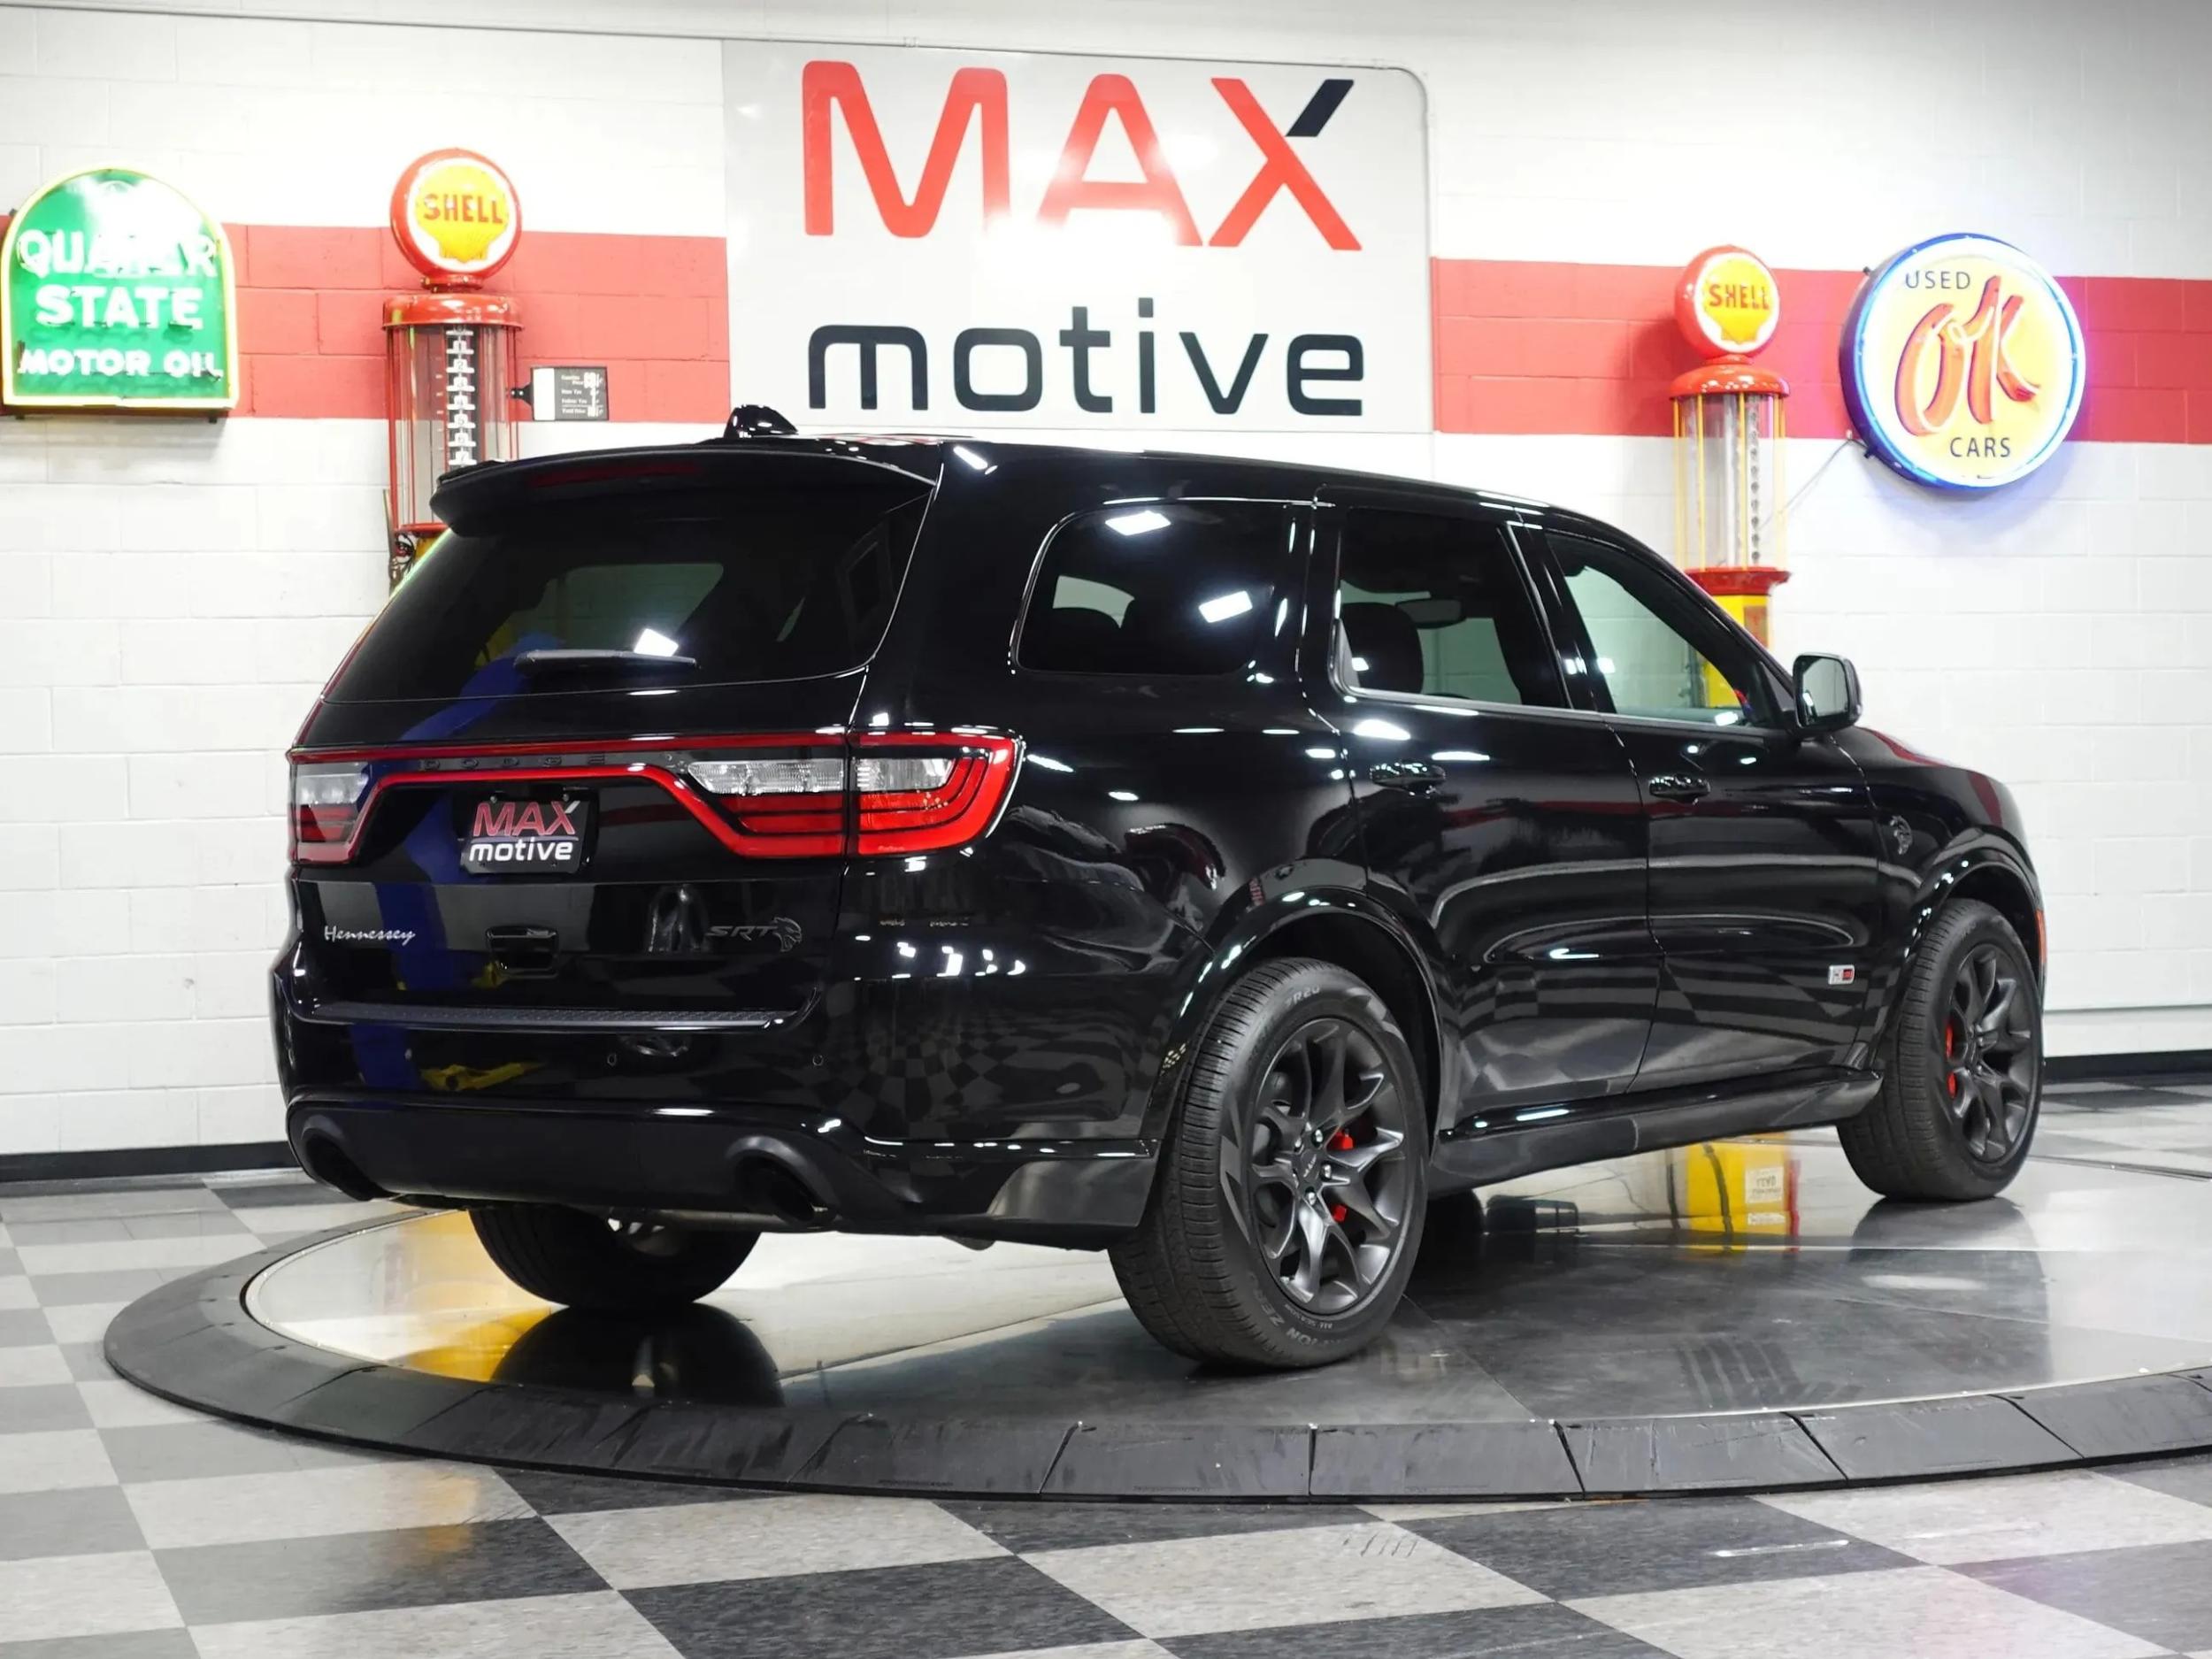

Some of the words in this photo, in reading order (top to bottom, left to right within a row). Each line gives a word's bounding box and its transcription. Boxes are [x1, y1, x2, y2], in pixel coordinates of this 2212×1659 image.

[802, 60, 1363, 251] MAX
[424, 193, 503, 224] SHELL
[1905, 271, 1971, 290] USED
[35, 284, 204, 330] STATE
[1709, 283, 1770, 311] SHELL
[18, 349, 151, 376] MOTOR
[164, 349, 224, 378] OIL
[808, 296, 1363, 416] motive
[1894, 275, 2041, 437] OK
[1949, 437, 2011, 457] CARS
[472, 800, 580, 836] MAX
[469, 837, 573, 862] motive
[324, 926, 416, 946] Hennessey
[705, 925, 778, 941] SRT
